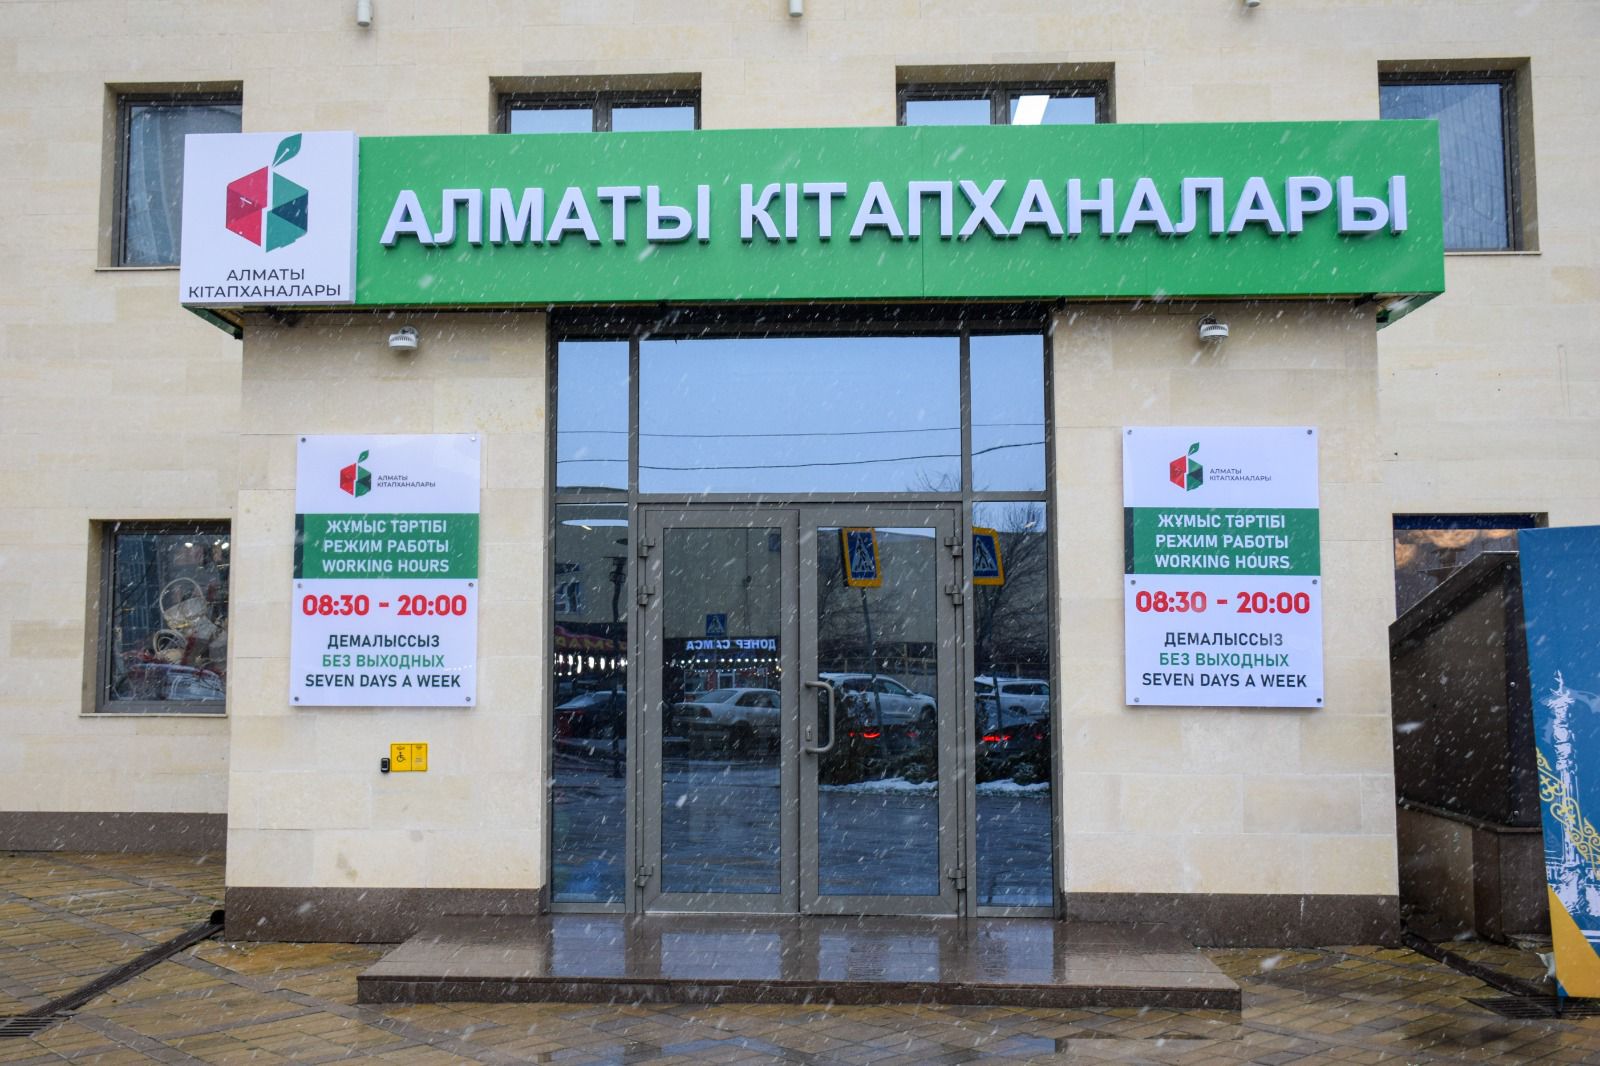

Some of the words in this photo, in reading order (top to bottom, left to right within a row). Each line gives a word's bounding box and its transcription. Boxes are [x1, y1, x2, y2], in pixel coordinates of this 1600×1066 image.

[379, 184, 710, 247] АЛМАТЫ
[739, 175, 1408, 242] КІТАПХАНАЛАРЫ
[226, 267, 305, 282] АЛМАТЫ
[188, 283, 341, 298] КІТАПХАНАЛАРЫ
[326, 520, 386, 532] ЖҰМЫС
[391, 520, 447, 533] ТӘРТІБІ
[1158, 515, 1221, 528] ЖҰМЫС
[1225, 515, 1285, 528] ТӘРТІБІ
[324, 540, 382, 552] РЕЖИМ
[388, 540, 449, 552] РАБОТЫ
[1156, 535, 1217, 547] РЕЖИМ
[1223, 535, 1288, 548] РАБОТЫ
[322, 560, 393, 572] WORKING
[398, 560, 449, 572] HOURS
[1155, 555, 1229, 568] WORKING
[1235, 555, 1289, 568] HOURS
[302, 595, 370, 616] 08:30
[397, 595, 467, 616] 20:00
[1136, 591, 1207, 613] 08:30
[1237, 592, 1310, 614] 20:00
[328, 635, 440, 649] ДЕМАЛЫССЫЗ
[1164, 633, 1283, 647] ДЕМАЛЫССЫЗ
[322, 655, 351, 667] БЕЗ
[356, 655, 444, 669] ВЫХОДНЫХ
[1159, 653, 1190, 666] БЕЗ
[1196, 653, 1288, 668] ВЫХОДНЫХ
[305, 675, 354, 687] SEVEN
[360, 675, 397, 687] DAYS
[402, 675, 412, 687] A
[417, 675, 460, 687] WEEK
[1142, 673, 1194, 686] SEVEN
[1200, 673, 1239, 687] DAYS
[1245, 674, 1255, 687] A
[1261, 675, 1307, 687] WEEK
